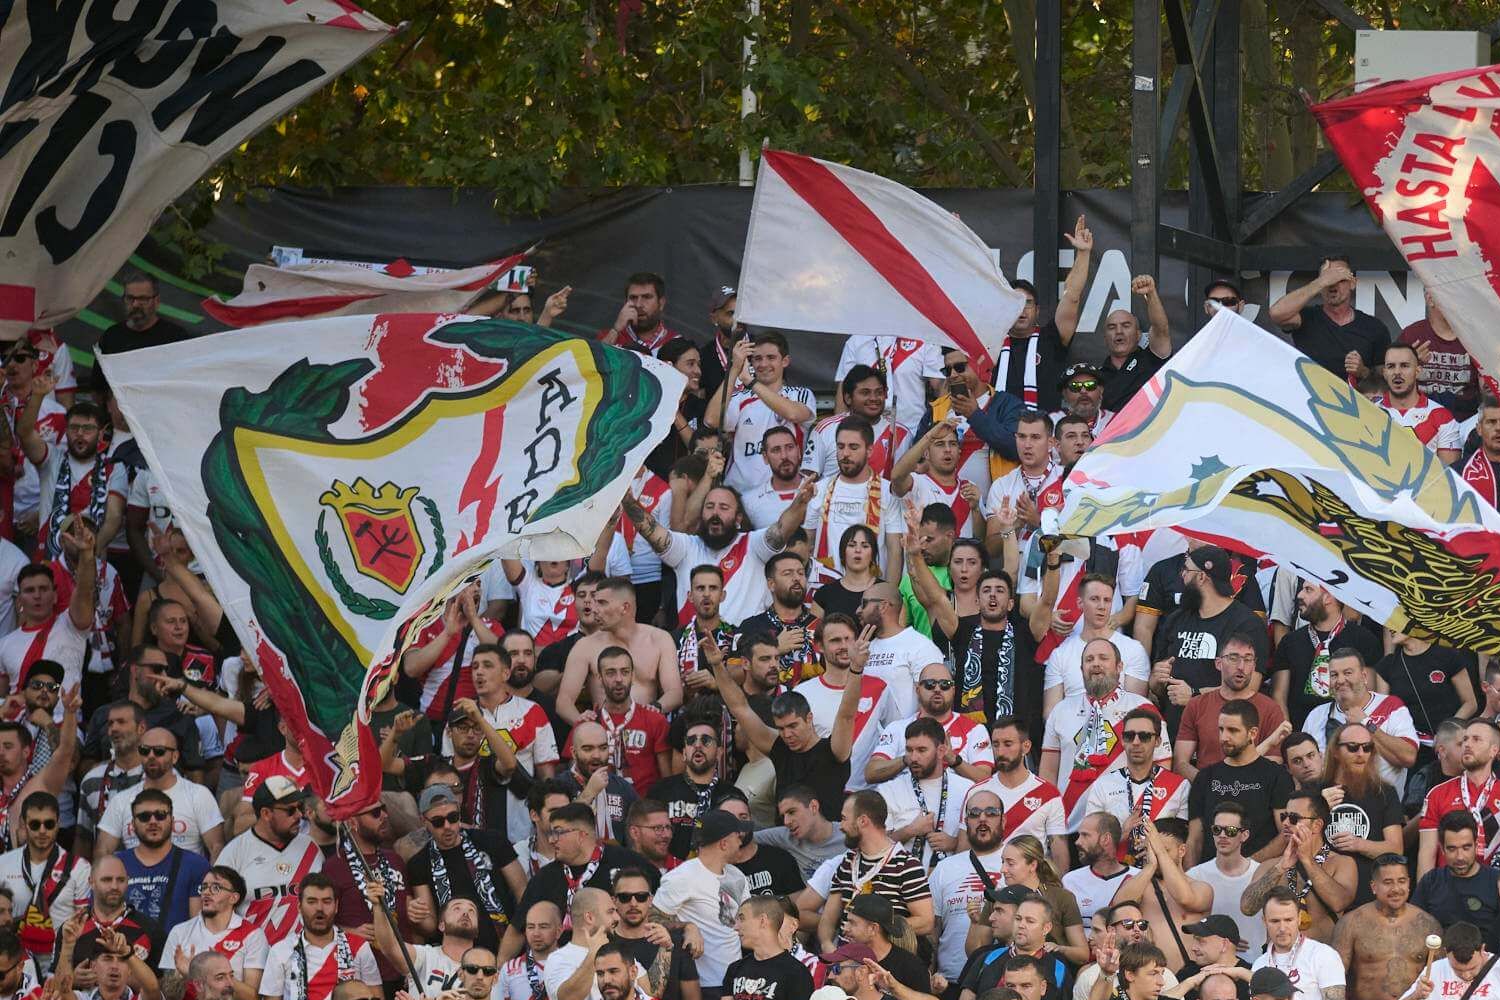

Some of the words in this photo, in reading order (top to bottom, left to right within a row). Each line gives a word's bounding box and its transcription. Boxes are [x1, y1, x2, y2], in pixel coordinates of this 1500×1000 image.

[1395, 137, 1466, 261] HASTA
[1432, 353, 1458, 365] NEW
[1428, 370, 1460, 381] YORK
